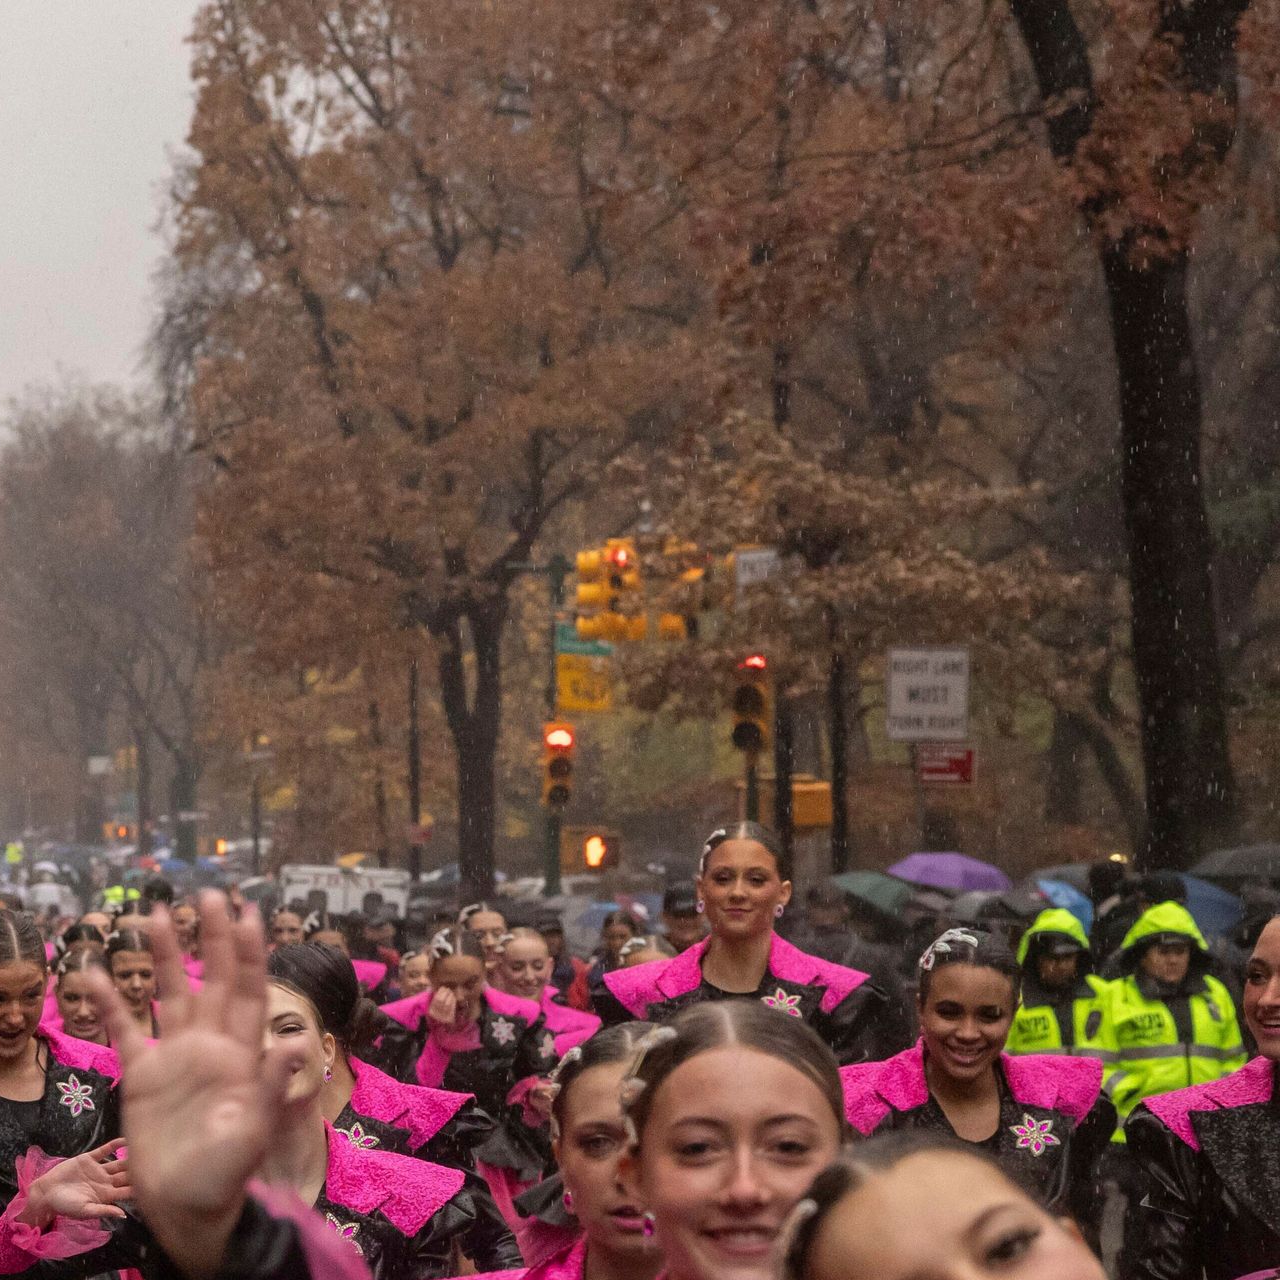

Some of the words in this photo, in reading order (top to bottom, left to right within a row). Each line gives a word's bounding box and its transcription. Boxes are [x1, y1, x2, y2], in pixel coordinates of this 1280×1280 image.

[893, 659, 929, 674] RIGHT
[908, 686, 949, 704] MUST
[891, 716, 924, 729] TURN
